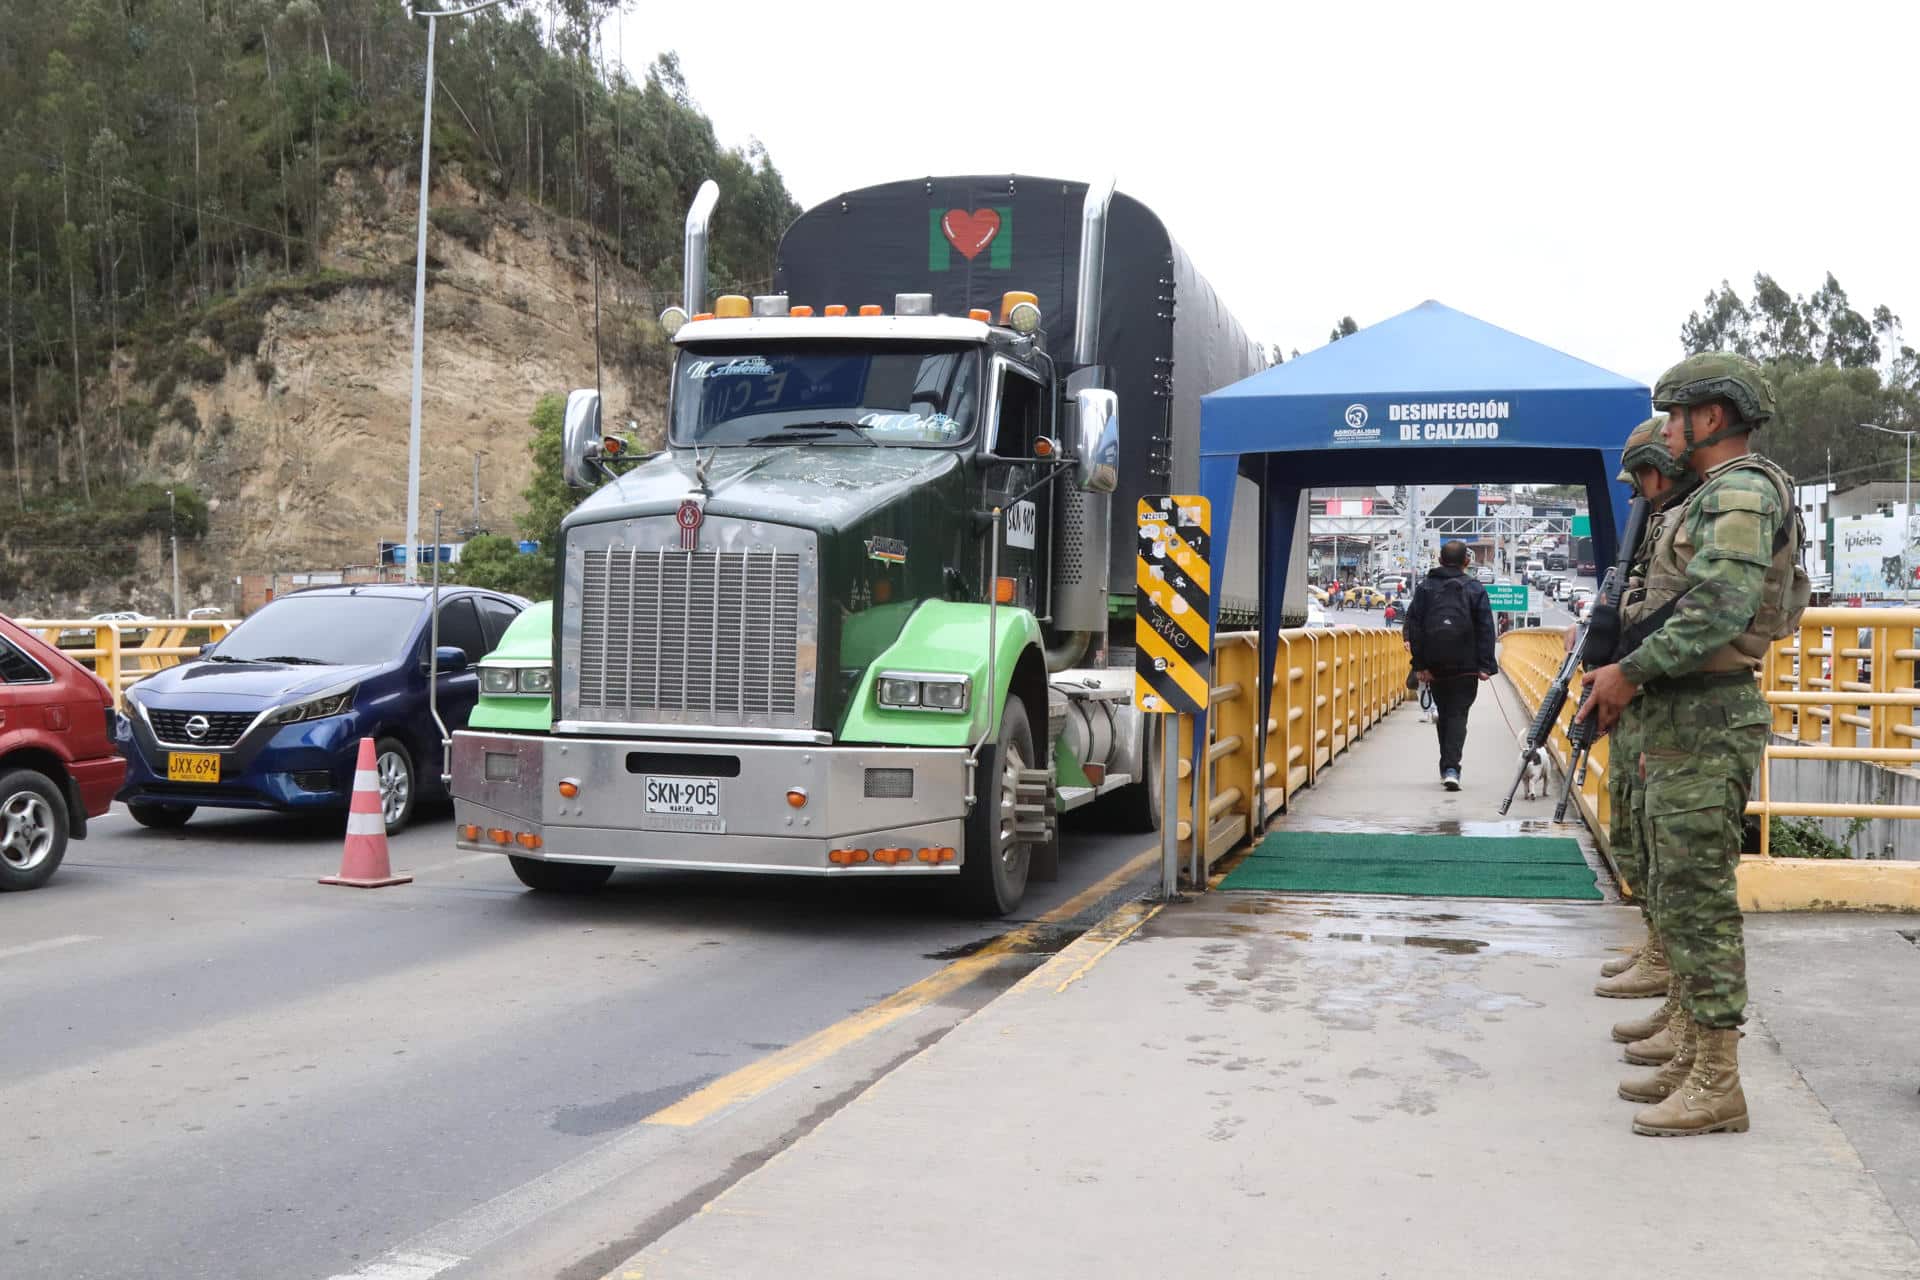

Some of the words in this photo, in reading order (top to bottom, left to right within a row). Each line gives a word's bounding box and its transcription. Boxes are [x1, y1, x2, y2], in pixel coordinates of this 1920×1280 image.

[1389, 400, 1509, 420] DESINFECCIÓN
[1400, 424, 1421, 440] DE
[1424, 422, 1499, 440] CALZADO
[648, 782, 716, 805] SKN-905
